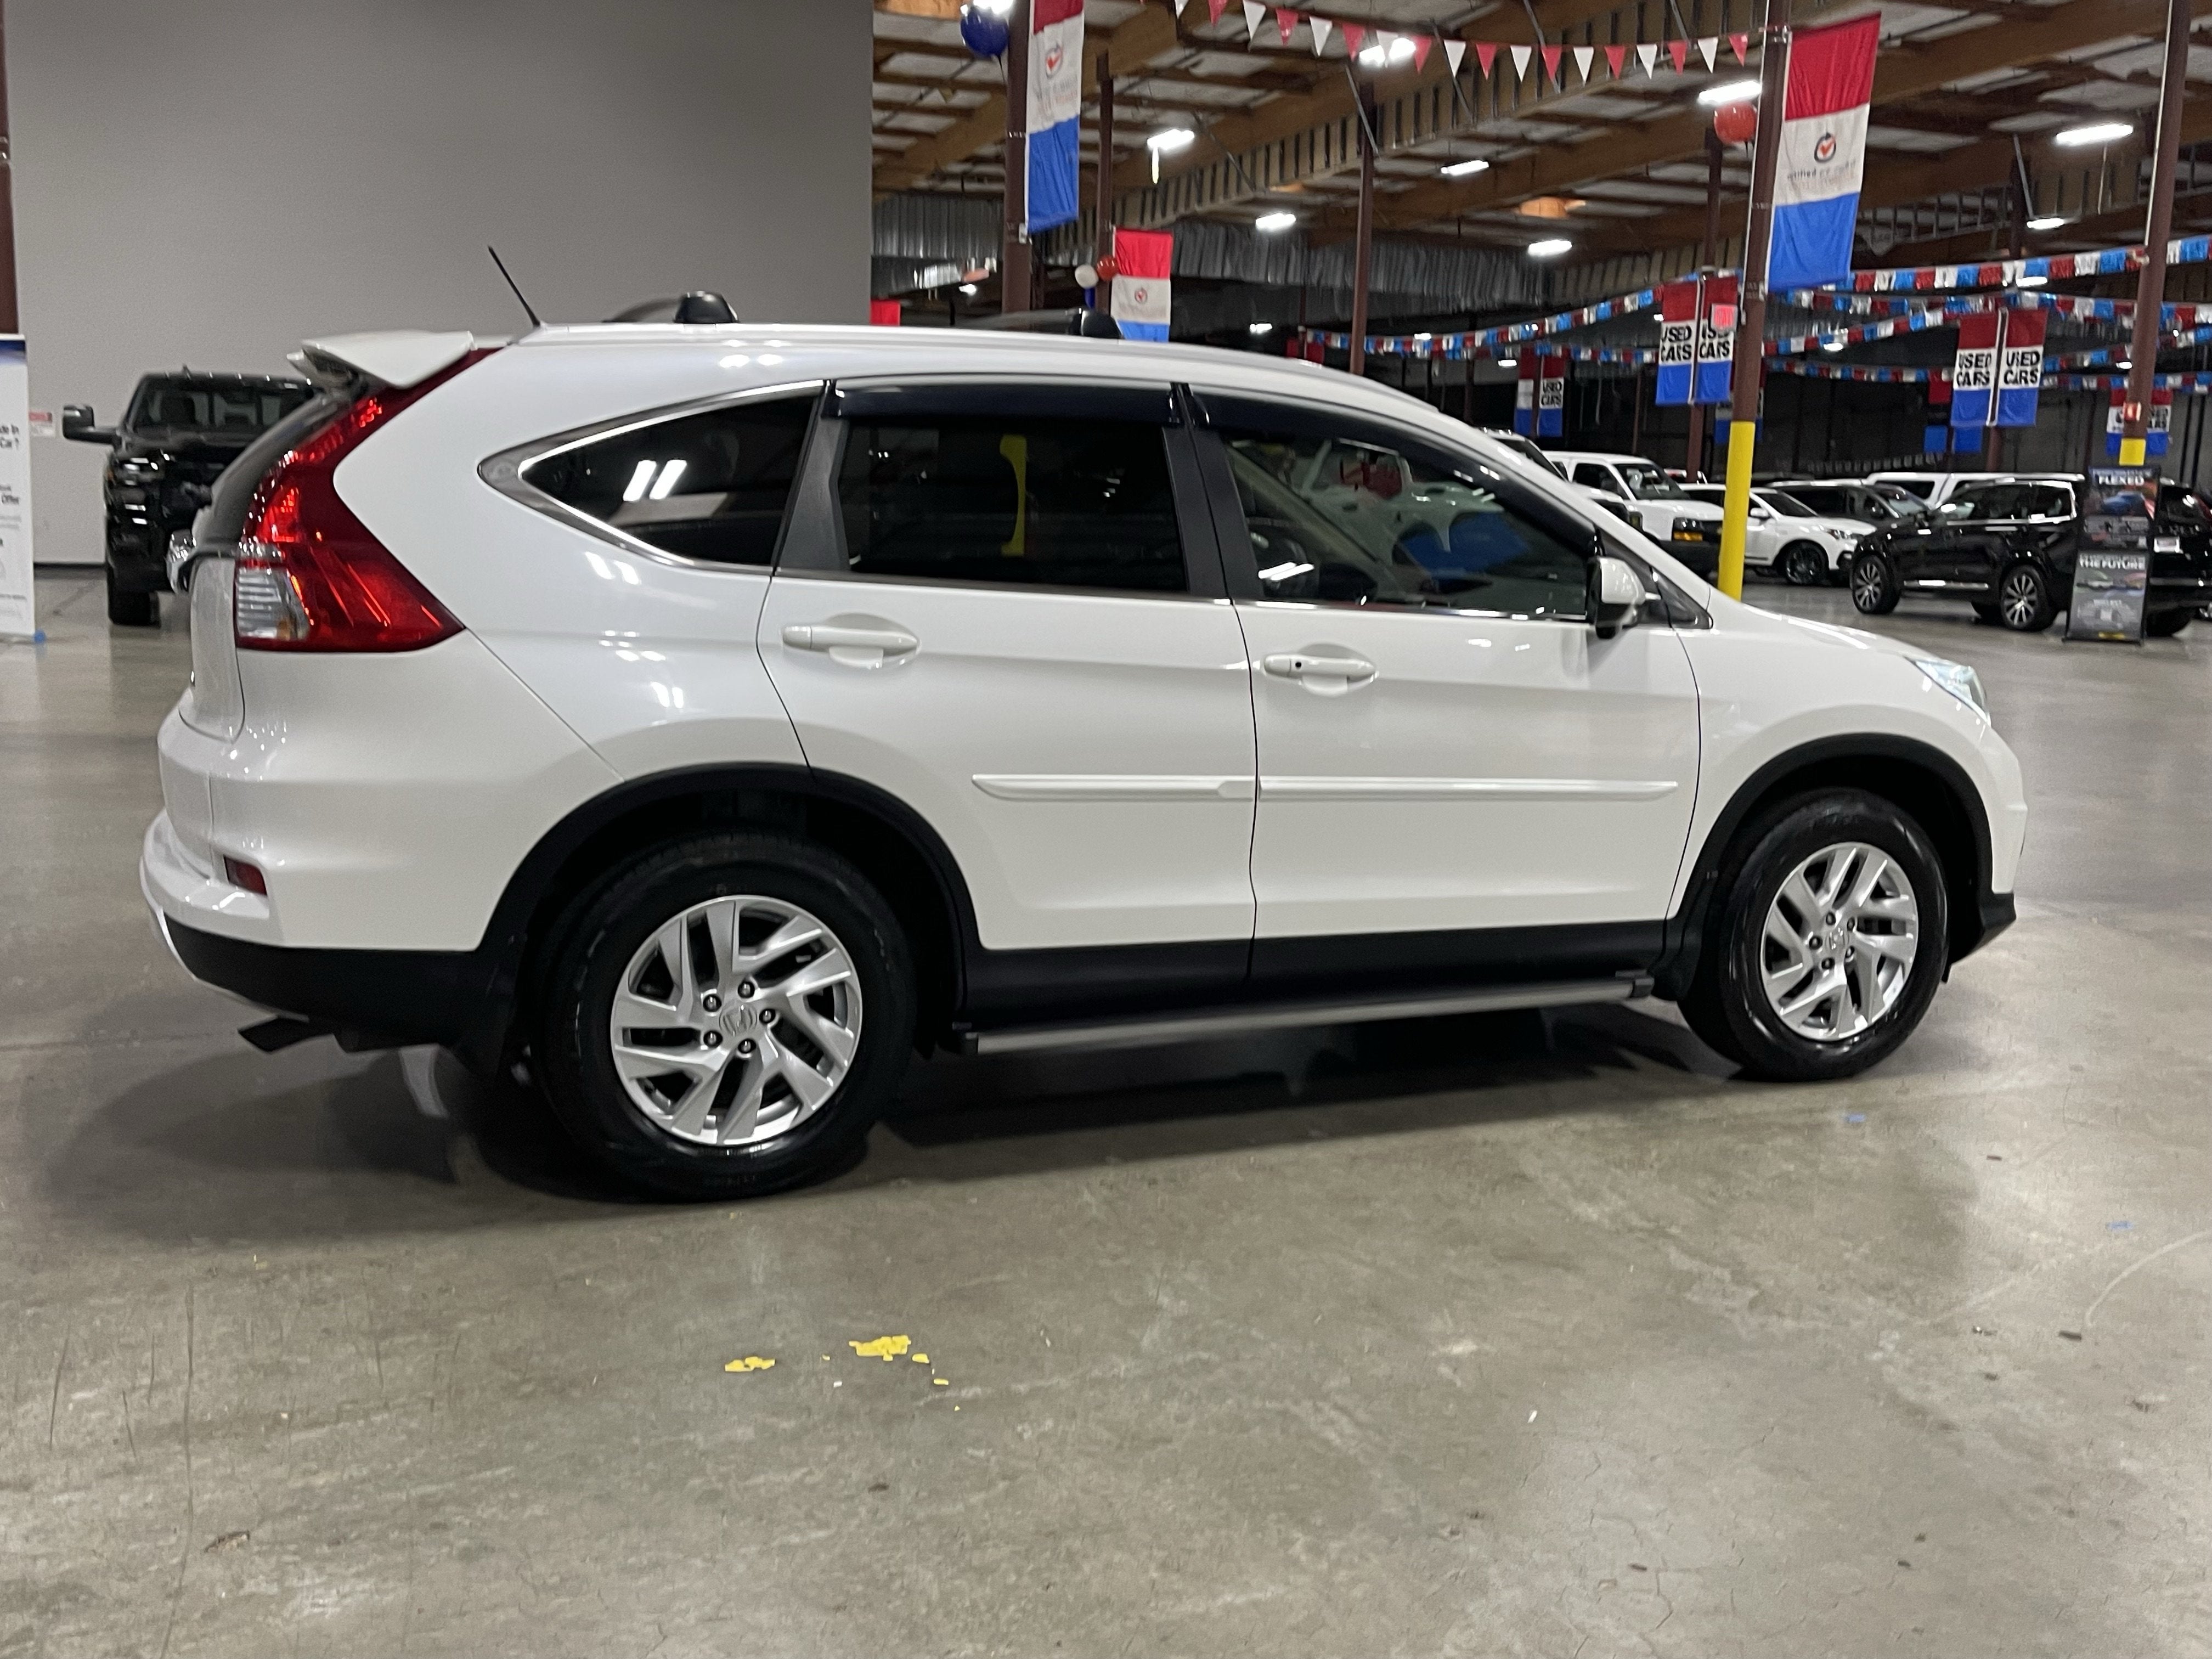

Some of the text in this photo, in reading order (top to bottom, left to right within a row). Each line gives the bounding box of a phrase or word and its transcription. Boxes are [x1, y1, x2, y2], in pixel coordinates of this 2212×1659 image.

[1959, 352, 1992, 369] USED
[2006, 351, 2041, 367] USED
[1956, 371, 1990, 386] CARS
[2004, 368, 2039, 385] CARS
